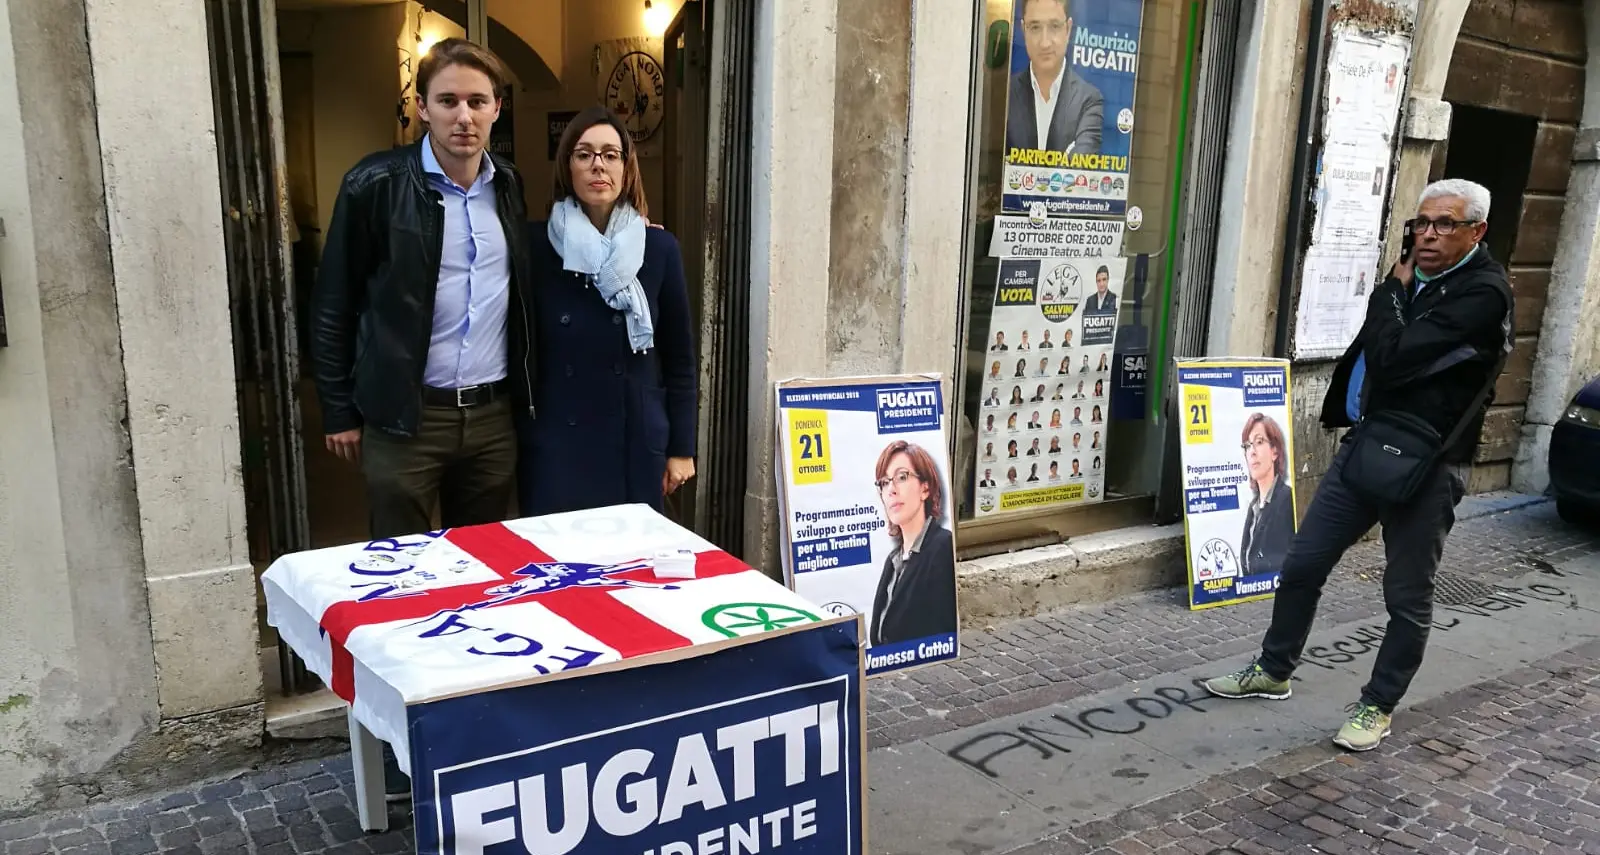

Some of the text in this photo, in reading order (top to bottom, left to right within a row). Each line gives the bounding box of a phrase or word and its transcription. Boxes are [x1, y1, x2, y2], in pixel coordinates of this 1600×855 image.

[1075, 26, 1136, 52] Maurizio
[1072, 46, 1136, 73] FUGATTI
[638, 58, 662, 96] NORD
[1010, 148, 1128, 171] PARTECIPA ANCHE TU!
[1000, 220, 1032, 230] Incontro
[1049, 220, 1083, 232] Matteo
[1084, 222, 1120, 233] SALVINI
[1004, 232, 1113, 245] 13 OTTOBRE ORE 20.00
[1012, 245, 1048, 256] Cinema
[1084, 248, 1102, 257] ALA
[1046, 266, 1078, 286] LEGA
[1000, 288, 1034, 302] VOTA
[1044, 304, 1074, 315] SALVINI
[1084, 316, 1114, 327] FUGATTI
[1244, 374, 1282, 386] FUGATTI
[812, 392, 845, 401] PROVINCIALI
[878, 390, 936, 408] FUGATTI
[884, 408, 932, 418] PRESIDENTE
[1190, 404, 1207, 424] 21
[795, 420, 822, 430] DOMENICA
[800, 434, 822, 460] 21
[798, 464, 826, 474] OTTOBRE
[1187, 462, 1244, 476] Programmazione,
[1188, 476, 1216, 487] sviluppo
[1222, 473, 1248, 485] coraggio
[1053, 492, 1080, 500] SCEGLIERE
[1188, 492, 1200, 502] per
[1210, 486, 1236, 497] Trentino
[795, 504, 878, 524] Programmazione,
[1189, 502, 1217, 514] migliore
[796, 518, 886, 538] sviluppo e coraggio
[797, 535, 868, 557] per un Trentino
[1200, 541, 1230, 562] LEGA
[798, 556, 838, 572] migliore
[1203, 578, 1232, 590] SALVINI
[1236, 578, 1272, 594] Vanessa
[864, 637, 954, 670] Vanessa Cattoi
[948, 678, 1213, 778] ANCOR
[451, 700, 839, 855] FUGATTI
